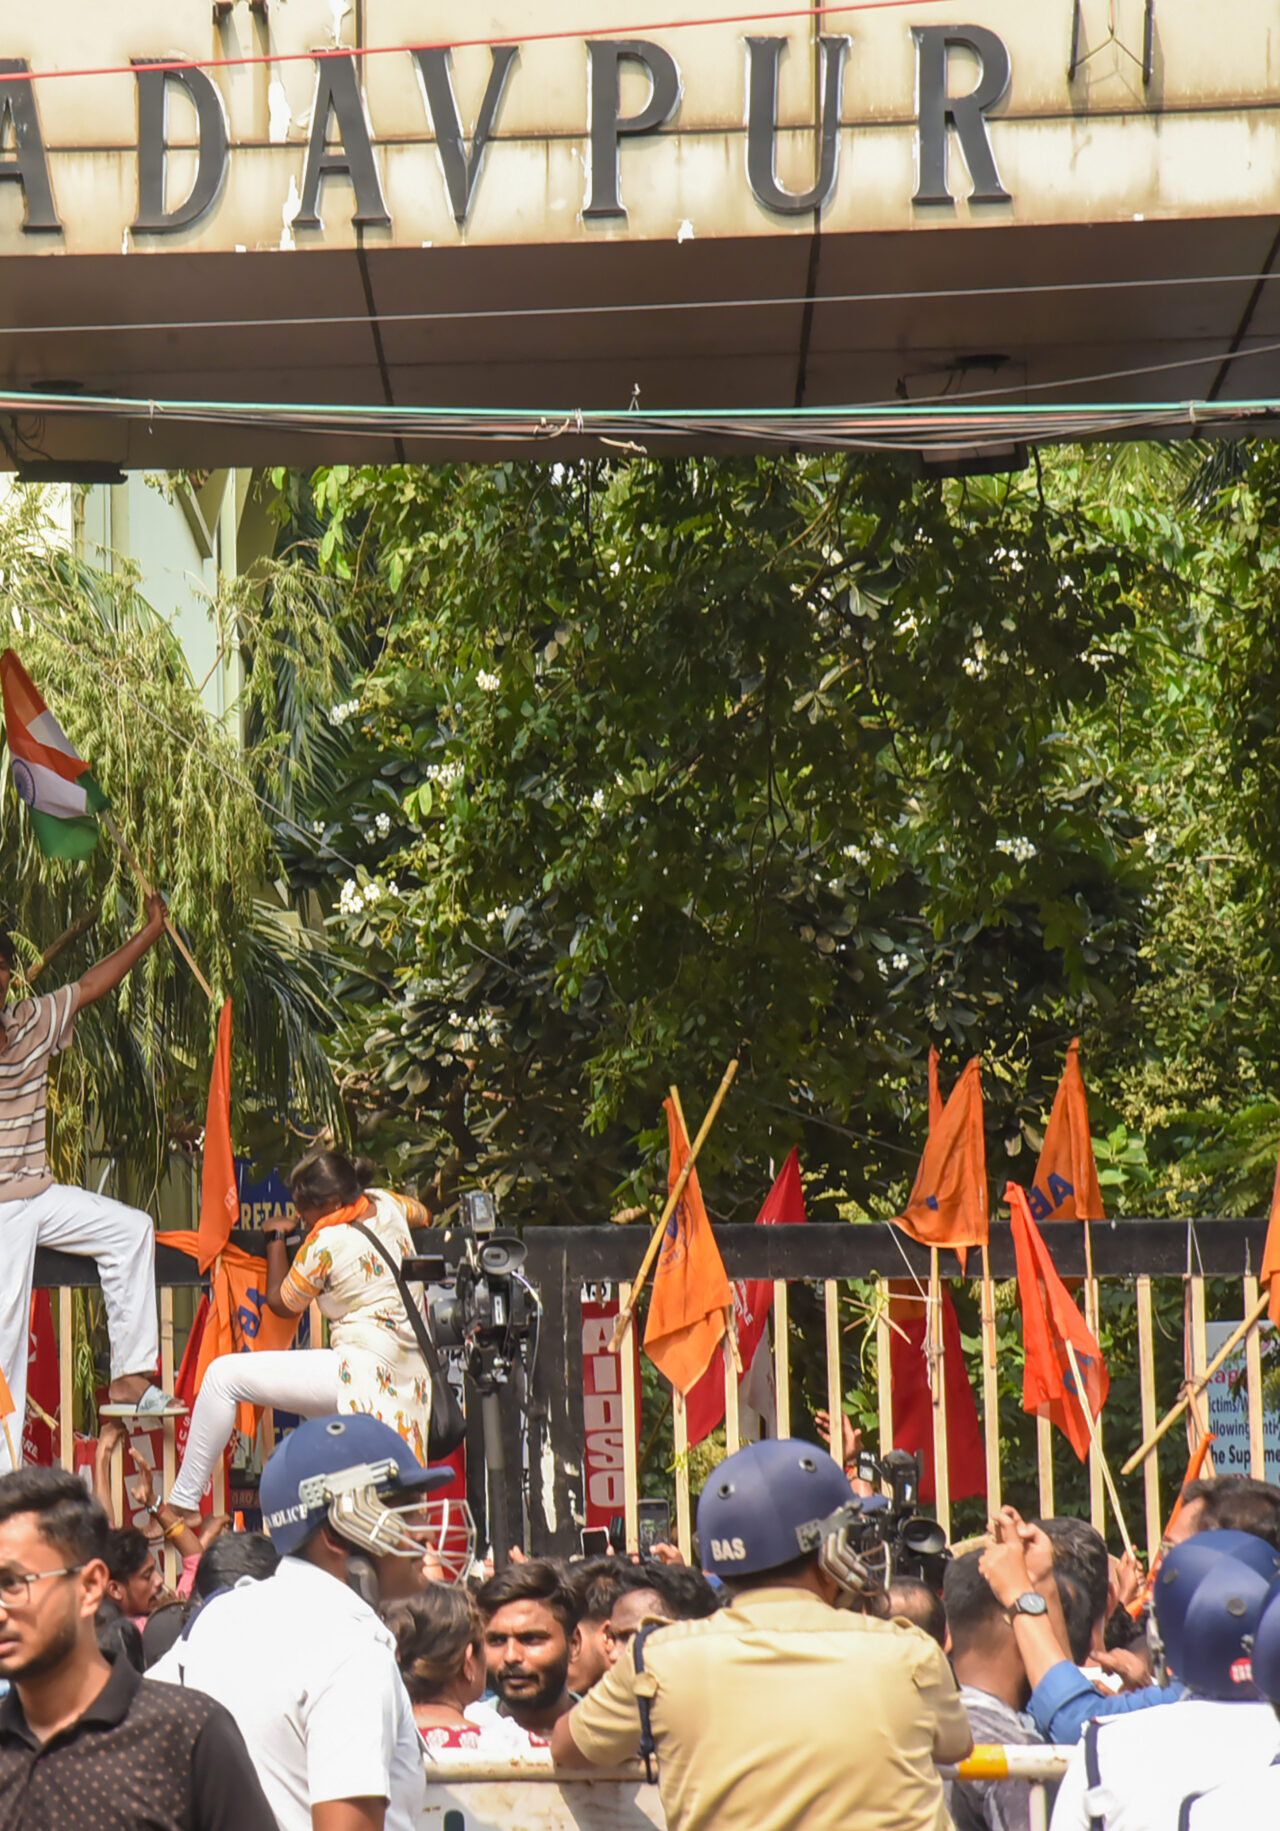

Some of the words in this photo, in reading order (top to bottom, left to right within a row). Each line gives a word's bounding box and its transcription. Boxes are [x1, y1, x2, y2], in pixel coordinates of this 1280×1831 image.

[582, 1318, 625, 1507] AIDSO
[1211, 1444, 1225, 1464] he
[711, 1537, 746, 1561] BAS
